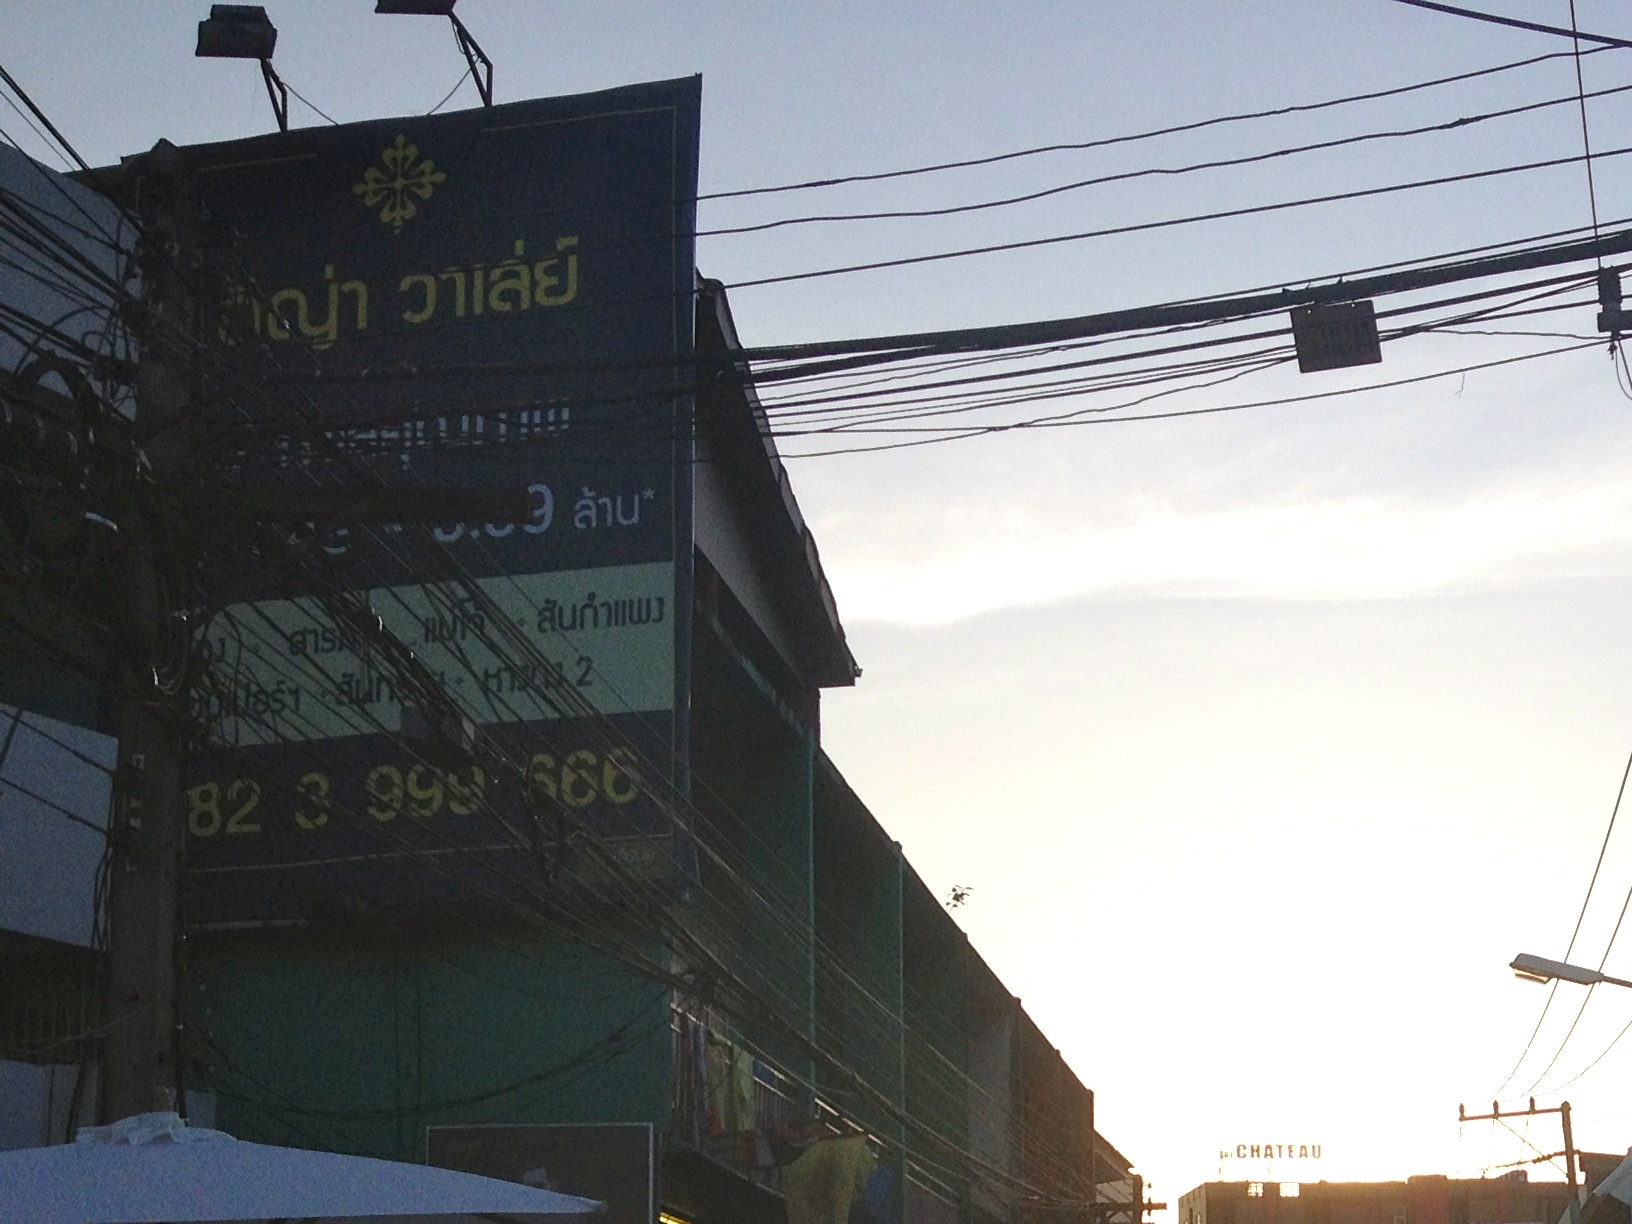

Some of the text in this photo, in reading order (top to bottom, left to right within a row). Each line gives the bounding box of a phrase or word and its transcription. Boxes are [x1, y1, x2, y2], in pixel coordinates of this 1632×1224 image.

[538, 592, 664, 633] สันกำแพง
[576, 655, 592, 686] 2
[294, 772, 332, 830] 3
[366, 763, 486, 822] 999
[526, 747, 641, 808] 666
[1236, 1144, 1321, 1159] CHATEAU
